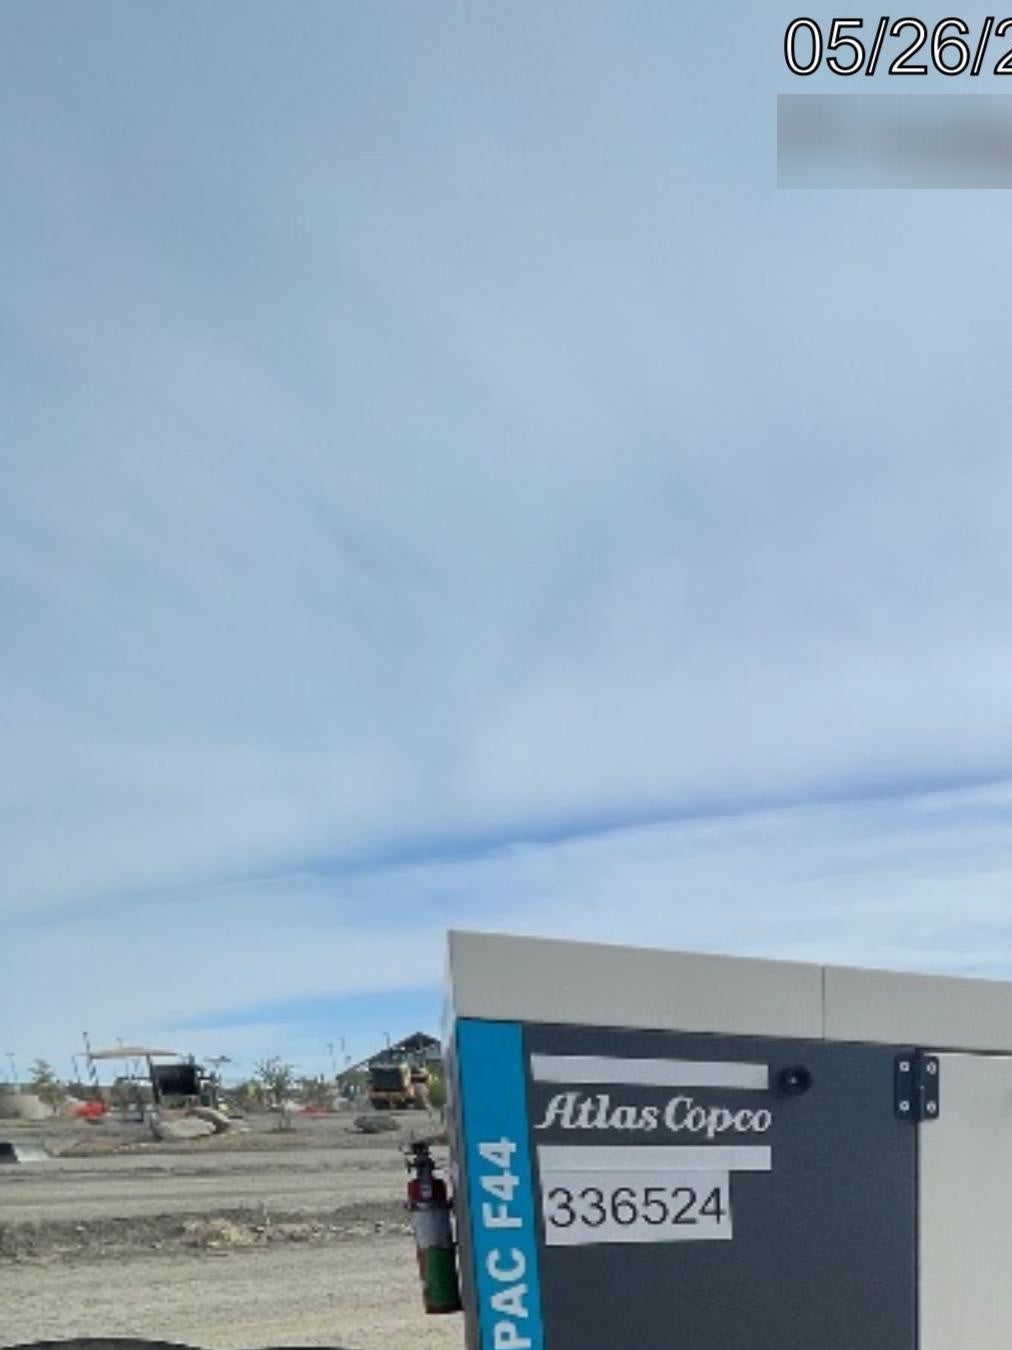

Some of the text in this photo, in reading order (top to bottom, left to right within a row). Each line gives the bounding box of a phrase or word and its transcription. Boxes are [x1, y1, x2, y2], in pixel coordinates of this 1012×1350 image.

[534, 1091, 772, 1139] Atlas Copco
[477, 1136, 524, 1230] F44
[547, 1186, 727, 1228] 336524
